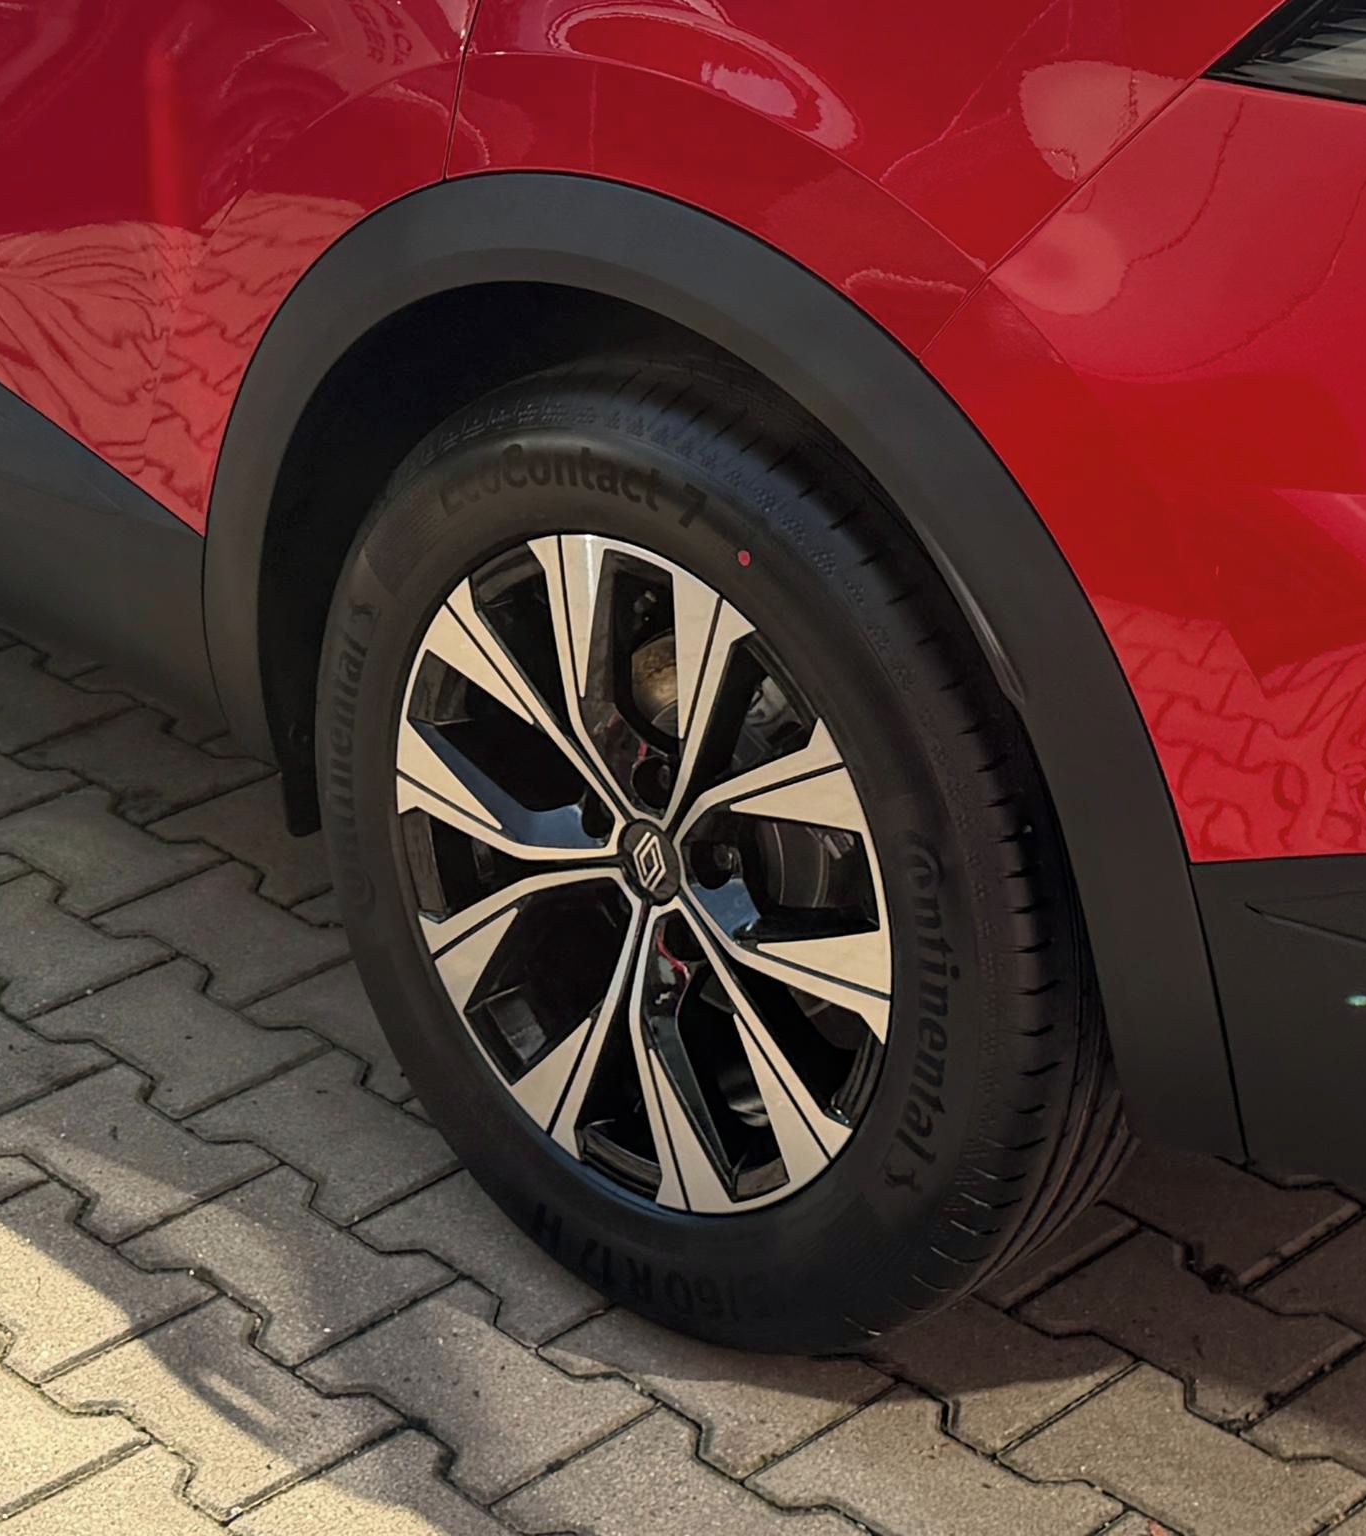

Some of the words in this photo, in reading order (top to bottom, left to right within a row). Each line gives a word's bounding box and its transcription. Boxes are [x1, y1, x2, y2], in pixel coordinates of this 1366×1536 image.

[438, 443, 663, 517] EcoContact
[677, 482, 708, 529] 7
[894, 828, 963, 1166] Continental
